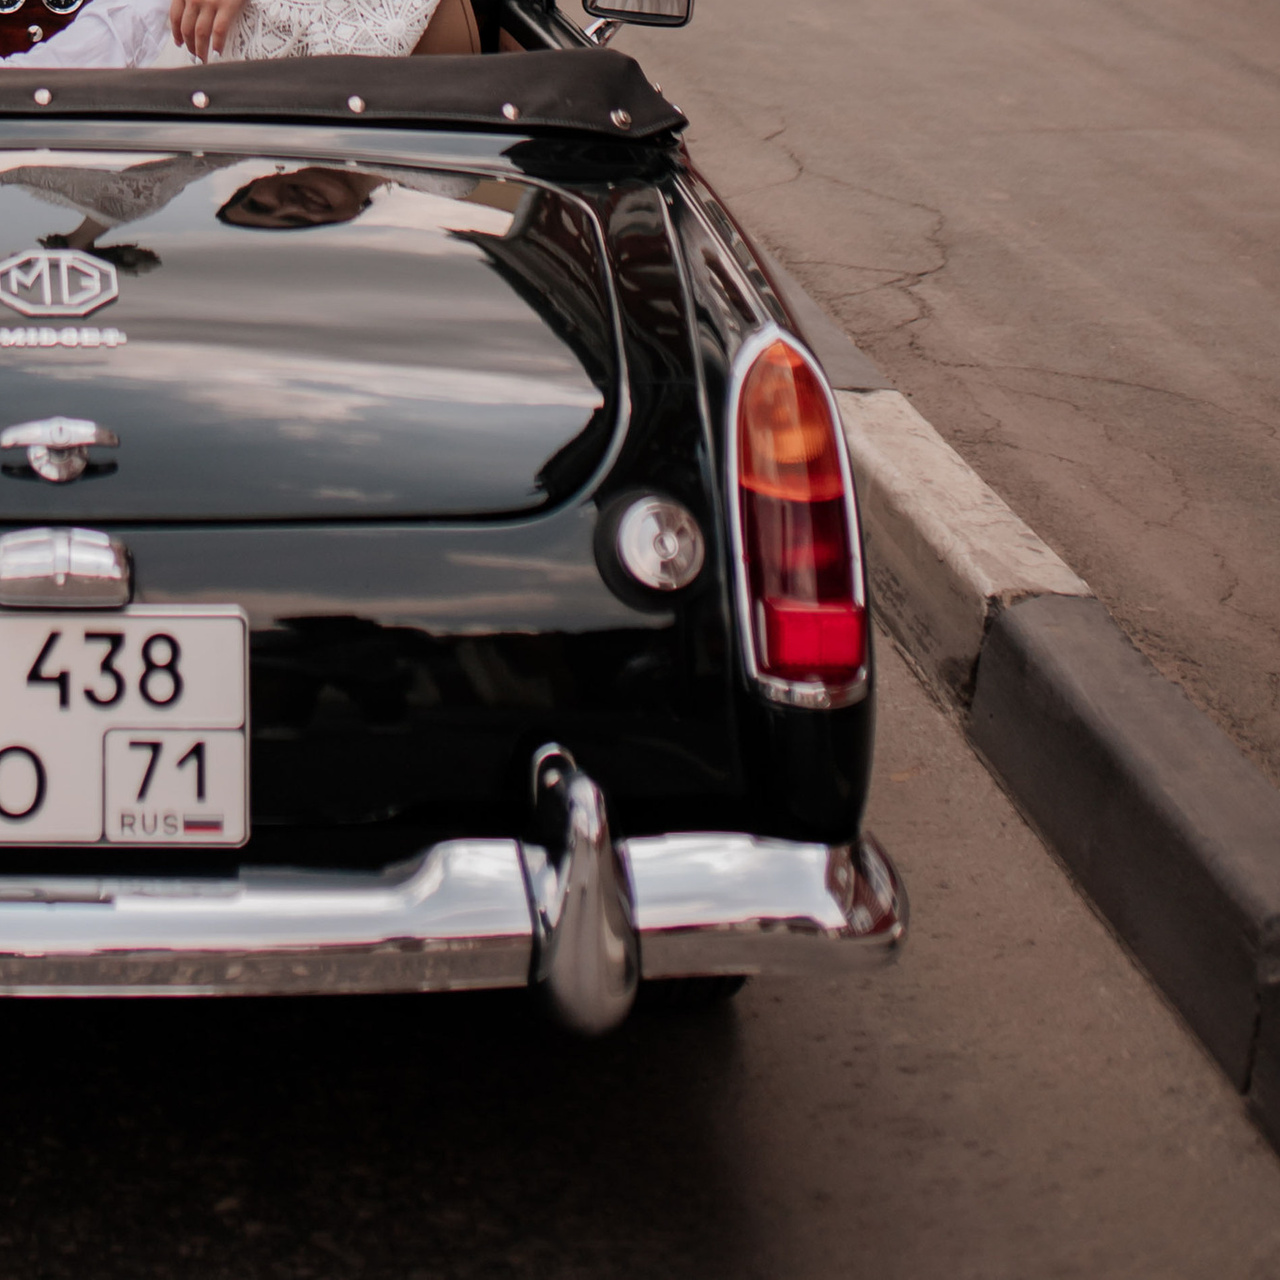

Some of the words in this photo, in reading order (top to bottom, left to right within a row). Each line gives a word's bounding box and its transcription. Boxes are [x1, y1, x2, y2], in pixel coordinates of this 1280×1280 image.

[6, 254, 105, 308] MG
[26, 631, 185, 710] 438
[129, 740, 207, 803] 71
[120, 813, 179, 836] RUS
